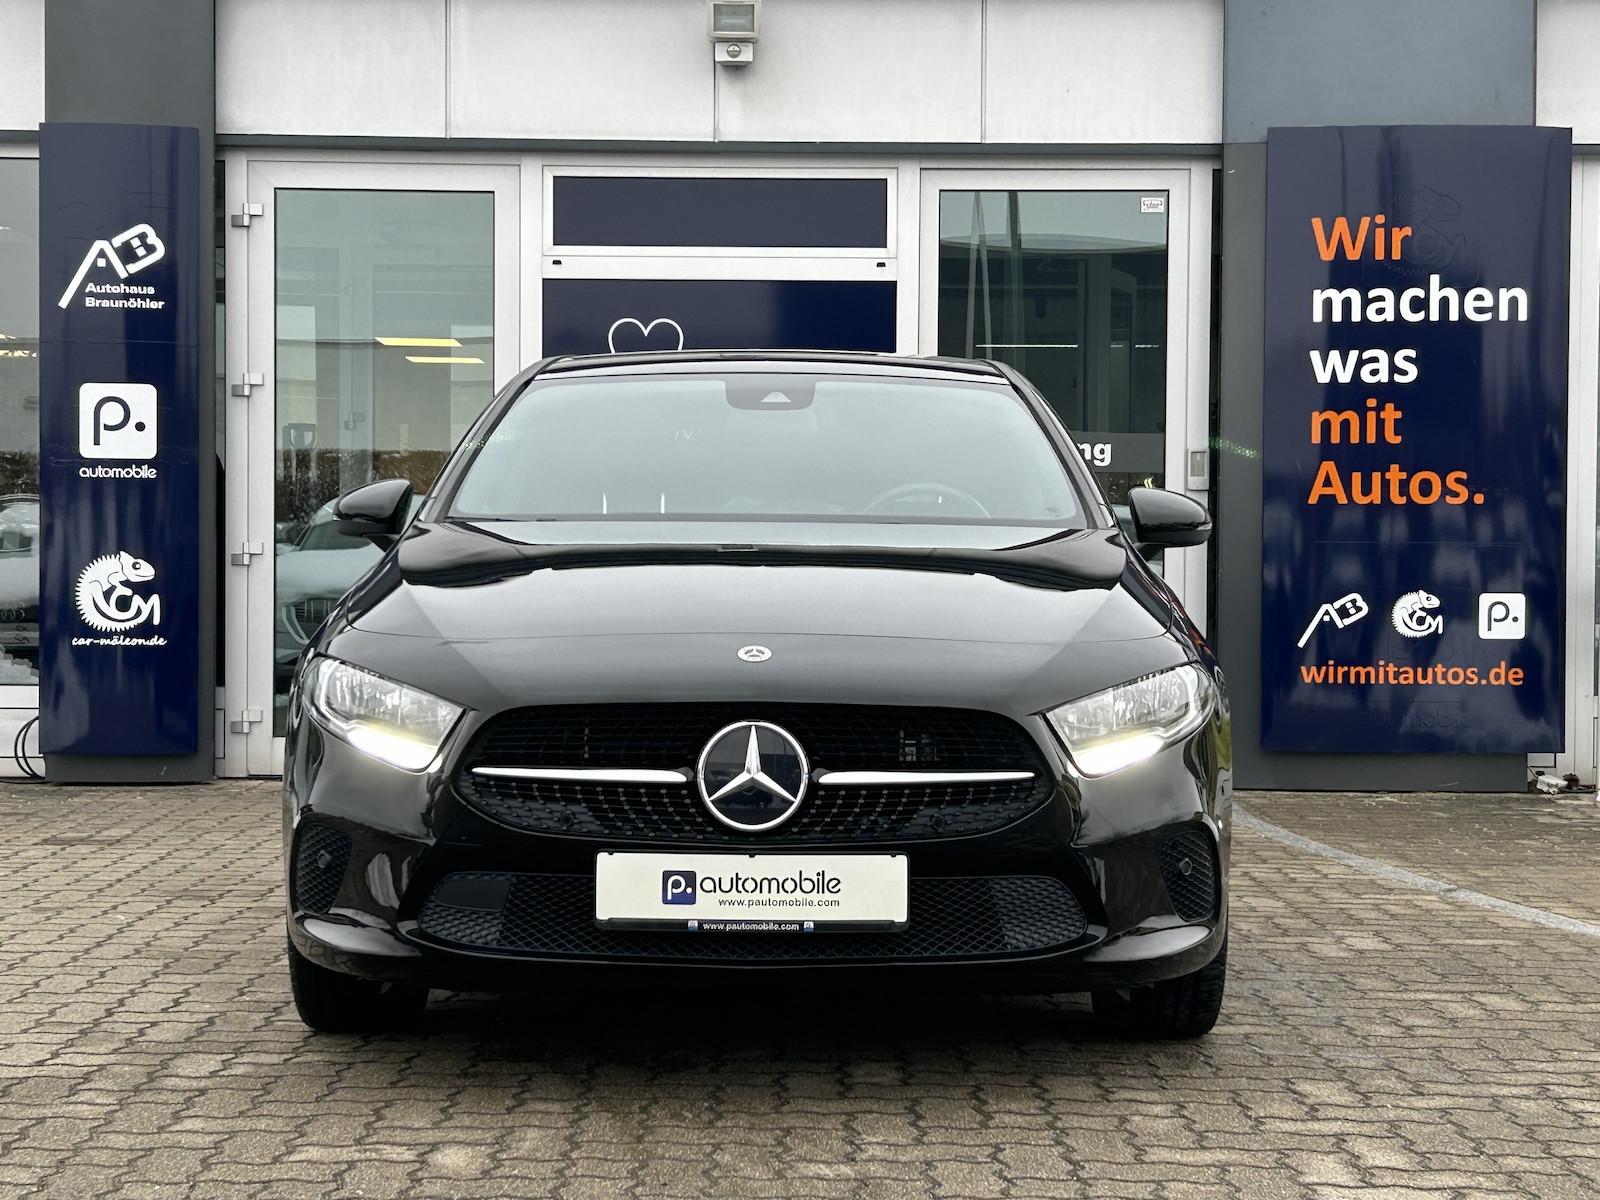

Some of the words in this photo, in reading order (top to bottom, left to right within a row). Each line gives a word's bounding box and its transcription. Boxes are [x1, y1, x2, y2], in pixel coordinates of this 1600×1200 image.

[1311, 214, 1412, 261] Wir
[85, 283, 155, 294] Autohaus
[1312, 274, 1528, 322] machen
[85, 297, 165, 309] Braunöhler
[1309, 348, 1418, 384] was
[1311, 398, 1402, 444] mit
[79, 464, 157, 478] automobile
[1308, 460, 1485, 505] Autos.
[1300, 660, 1524, 686] wirmitautos.de
[700, 870, 841, 894] automobile
[718, 898, 840, 908] www.pautomobile.com
[703, 922, 800, 931] www.pautomobile.com
